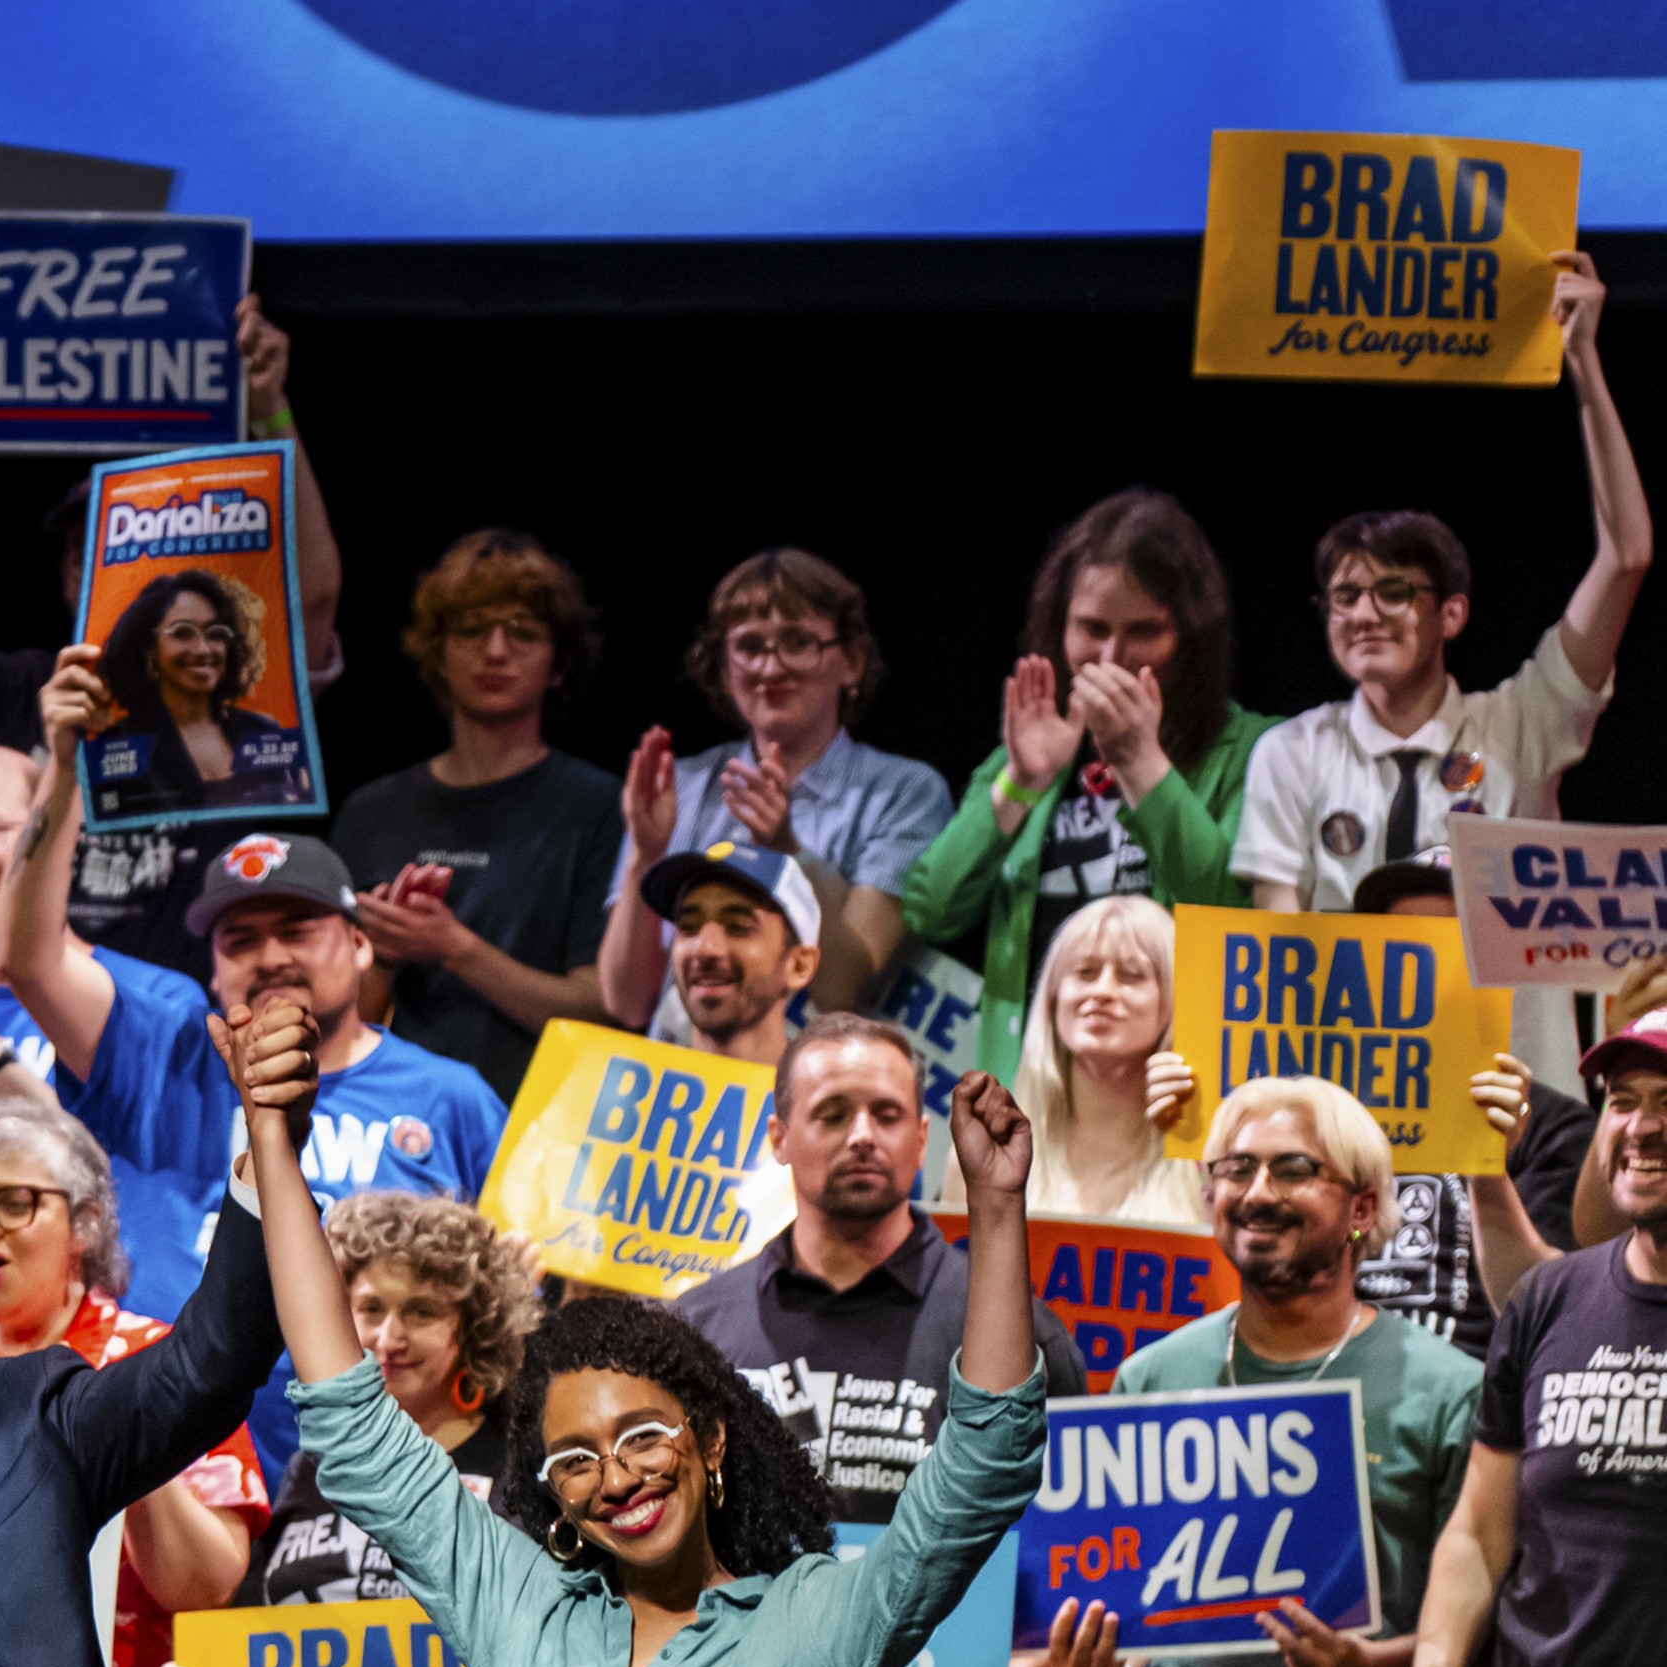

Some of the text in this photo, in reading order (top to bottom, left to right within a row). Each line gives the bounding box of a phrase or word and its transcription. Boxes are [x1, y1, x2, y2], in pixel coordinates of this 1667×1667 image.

[1281, 152, 1508, 244] BRAD
[1273, 242, 1500, 320] LANDER
[1268, 320, 1491, 367] for Congress
[106, 493, 267, 547] Darializa
[1526, 943, 1589, 965] FOR
[1223, 933, 1436, 1030] BRAD
[545, 1222, 605, 1255] for
[1588, 1345, 1631, 1368] New
[837, 1374, 937, 1409] Jews For
[832, 1401, 925, 1436] Racial &
[830, 1461, 906, 1491] Justice
[1036, 1411, 1315, 1512] UNIONS
[1578, 1447, 1601, 1474] of
[1049, 1507, 1306, 1606] FOR ALL
